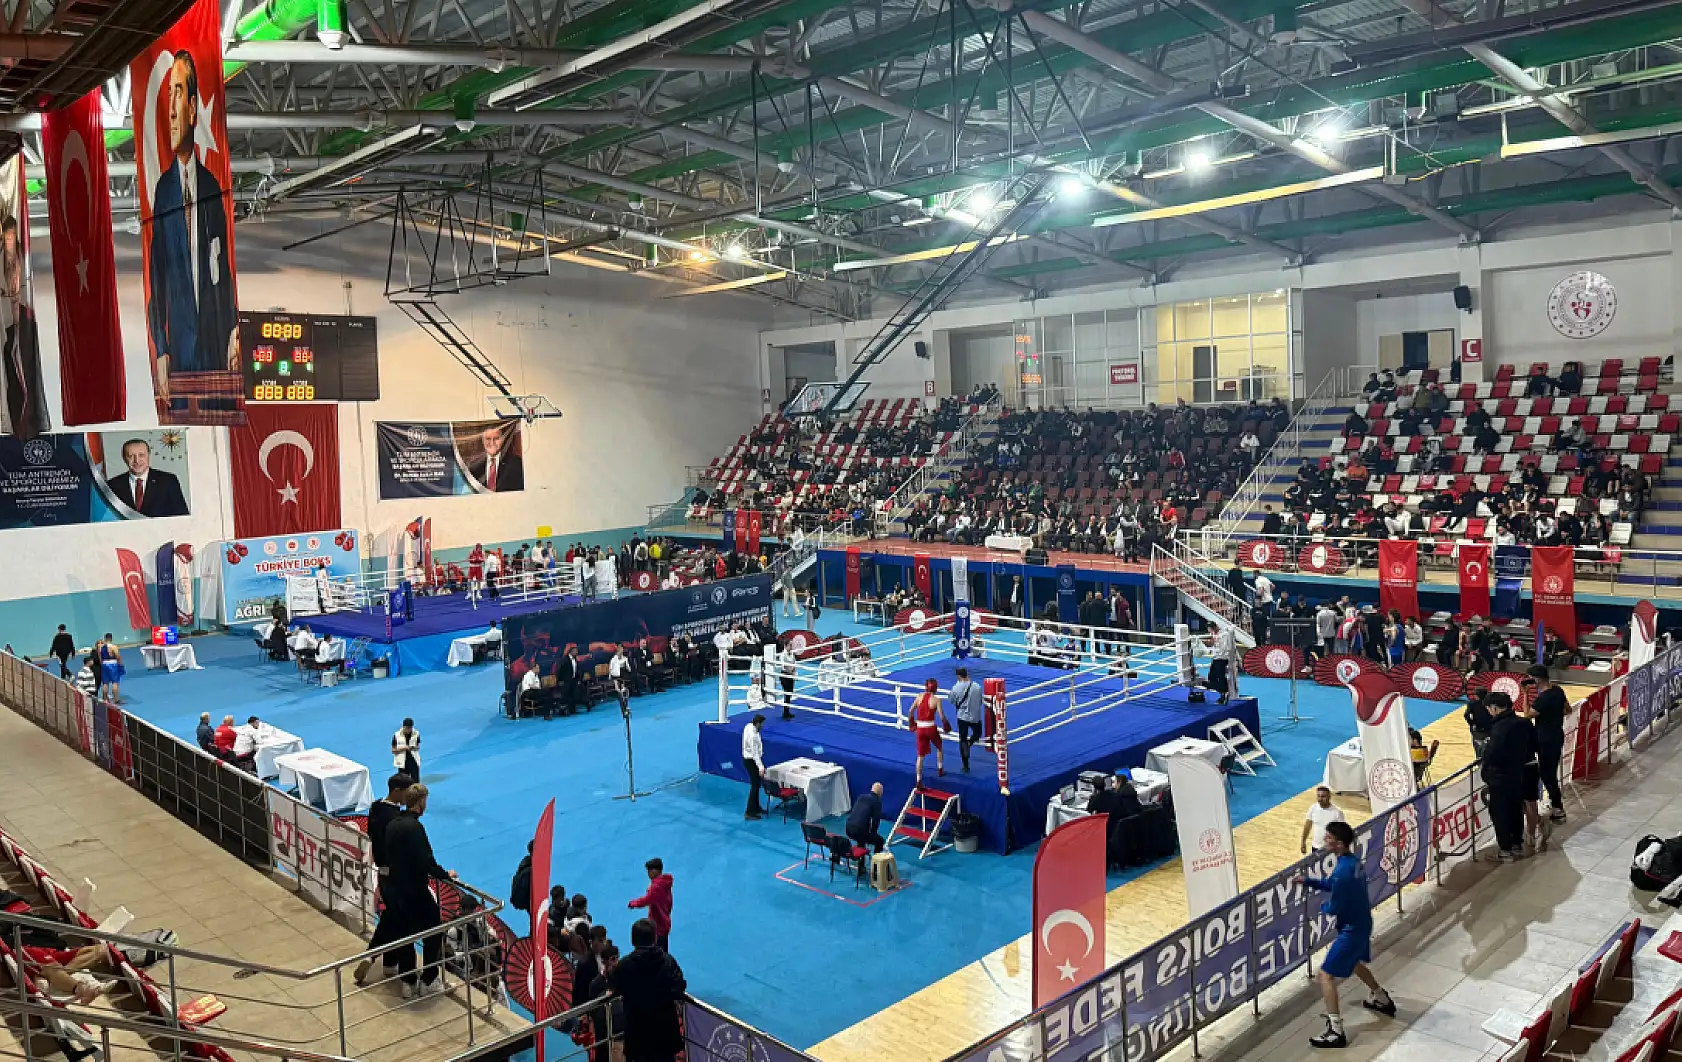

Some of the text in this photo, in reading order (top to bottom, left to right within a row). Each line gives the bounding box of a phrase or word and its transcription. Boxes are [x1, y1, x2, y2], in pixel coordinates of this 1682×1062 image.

[1466, 340, 1479, 357] C
[927, 381, 934, 393] B
[255, 556, 332, 573] TÜRKİYE BOKS
[235, 603, 265, 618] AĞRI
